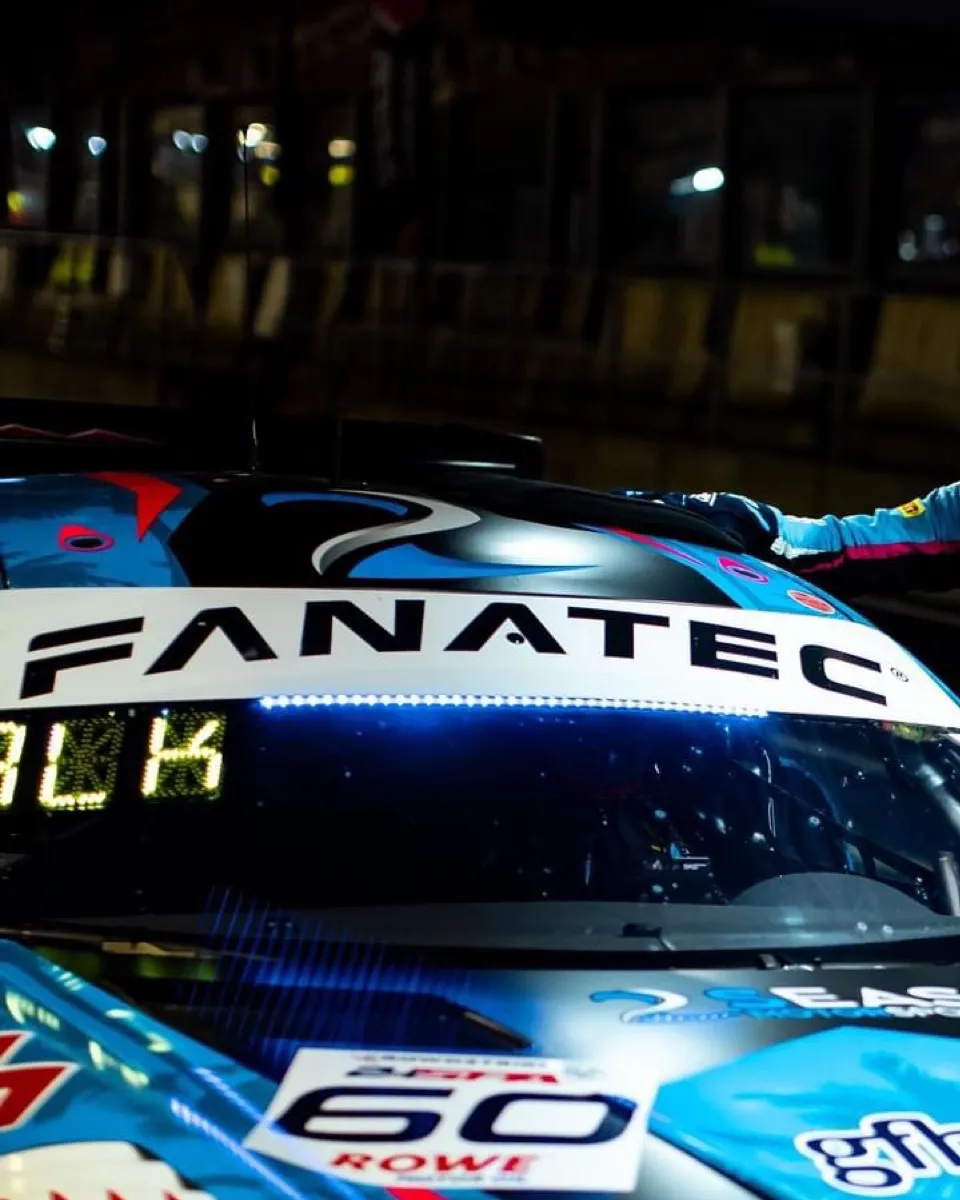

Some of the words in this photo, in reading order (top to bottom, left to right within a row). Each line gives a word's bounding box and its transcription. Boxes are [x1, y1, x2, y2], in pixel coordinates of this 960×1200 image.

[20, 599, 888, 706] FANATEC
[270, 1086, 638, 1145] 60
[330, 1153, 540, 1174] ROWE
